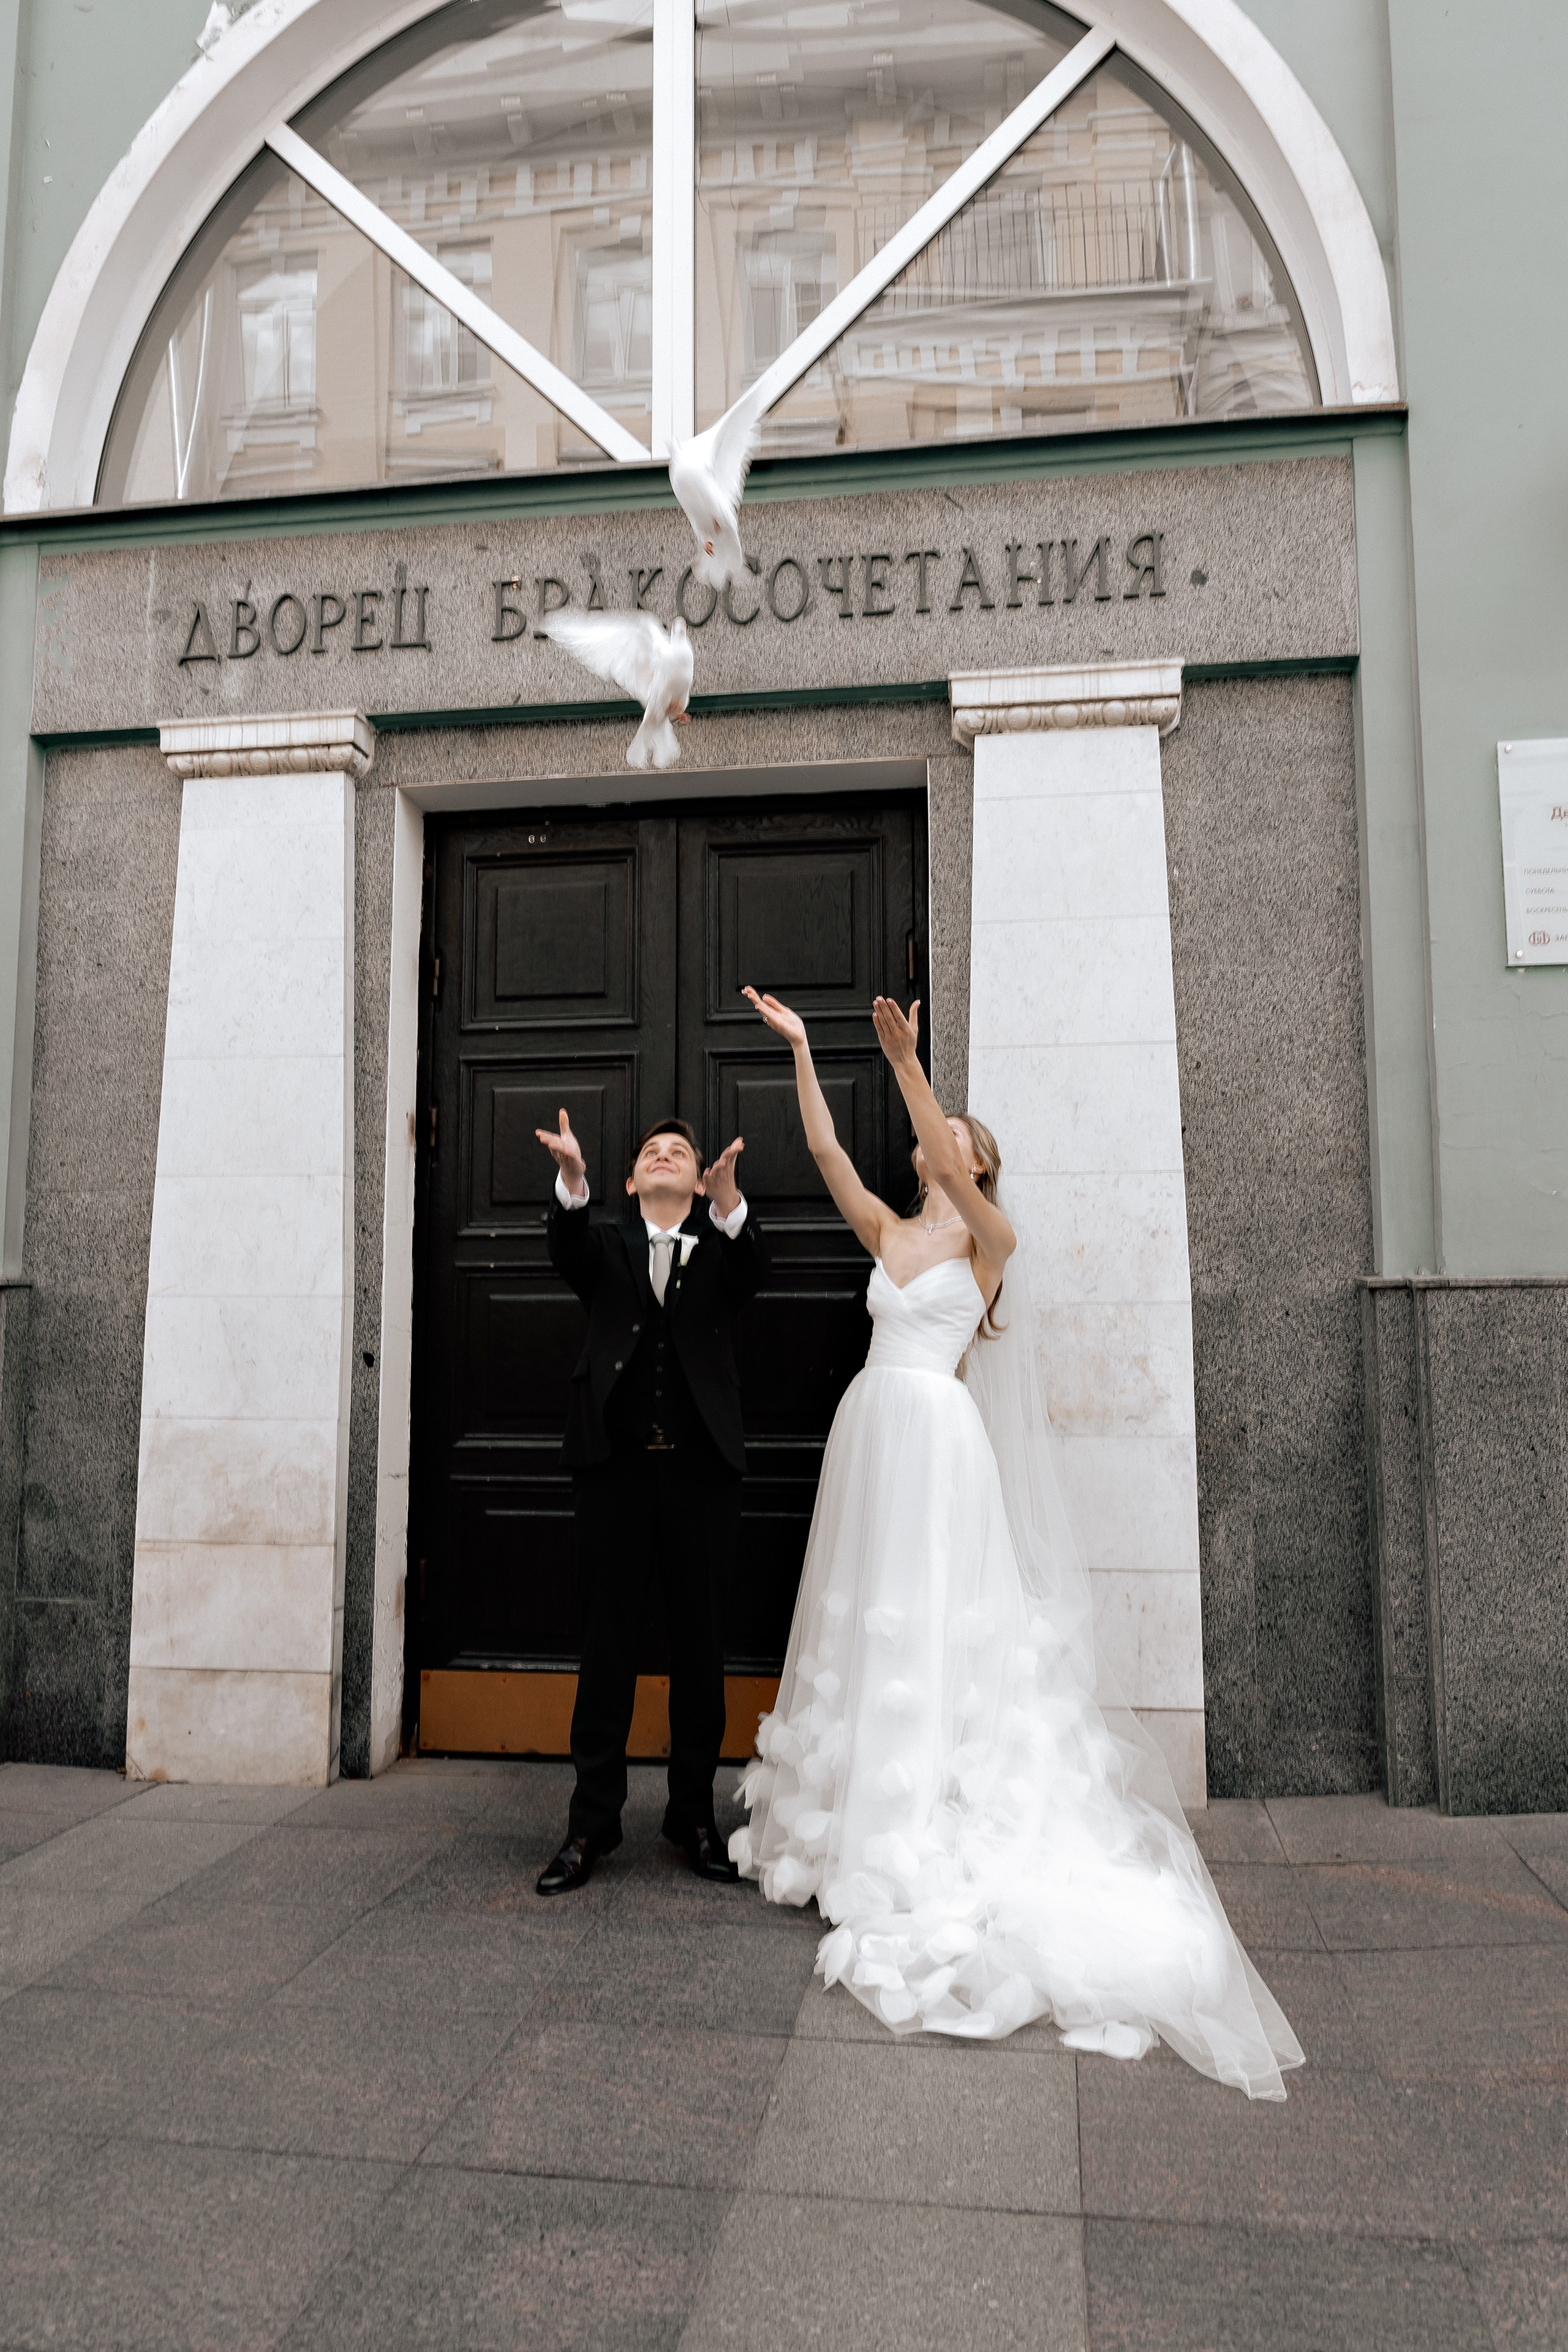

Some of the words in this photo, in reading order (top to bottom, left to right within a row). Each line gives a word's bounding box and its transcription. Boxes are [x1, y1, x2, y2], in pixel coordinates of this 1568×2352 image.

[178, 586, 432, 666] ДВОРЕЦ
[491, 532, 1166, 642] БРАКОСОЧЕТАНИЯ
[1525, 886, 1555, 895] СУББОТА
